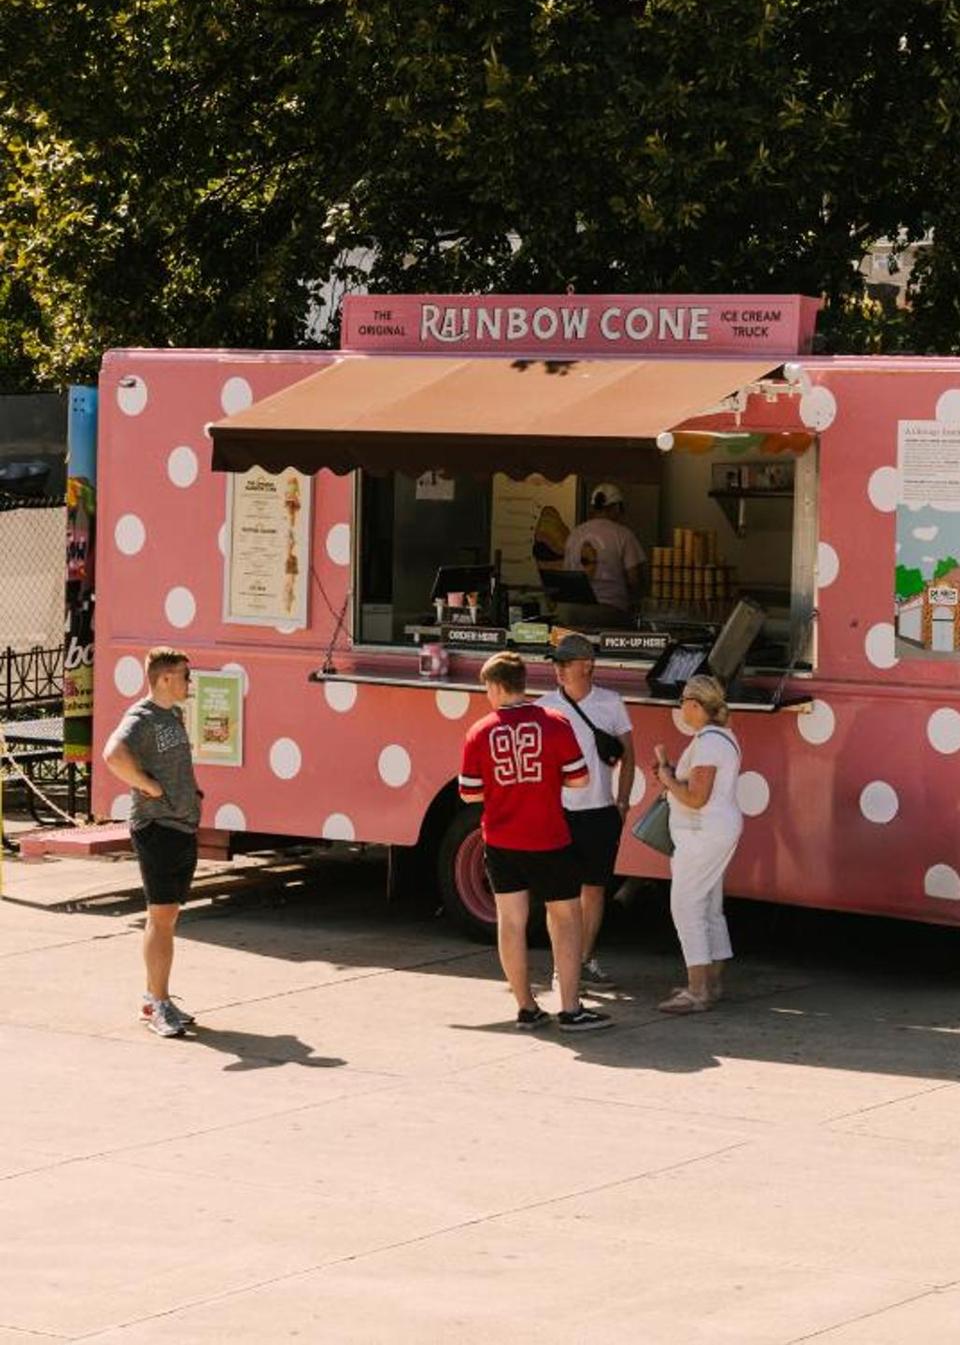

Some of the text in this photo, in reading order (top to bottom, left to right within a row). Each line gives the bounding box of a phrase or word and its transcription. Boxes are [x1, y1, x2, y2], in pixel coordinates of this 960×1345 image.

[373, 310, 392, 320] THE
[720, 310, 781, 322] ICE CREAM
[420, 303, 709, 342] RAINBOW CONE
[358, 325, 405, 336] ORIGINAL
[733, 326, 768, 337] TRUCK
[449, 630, 499, 642] ORDER HERE
[605, 637, 667, 649] PICK-UP HERE
[489, 722, 542, 786] 92
